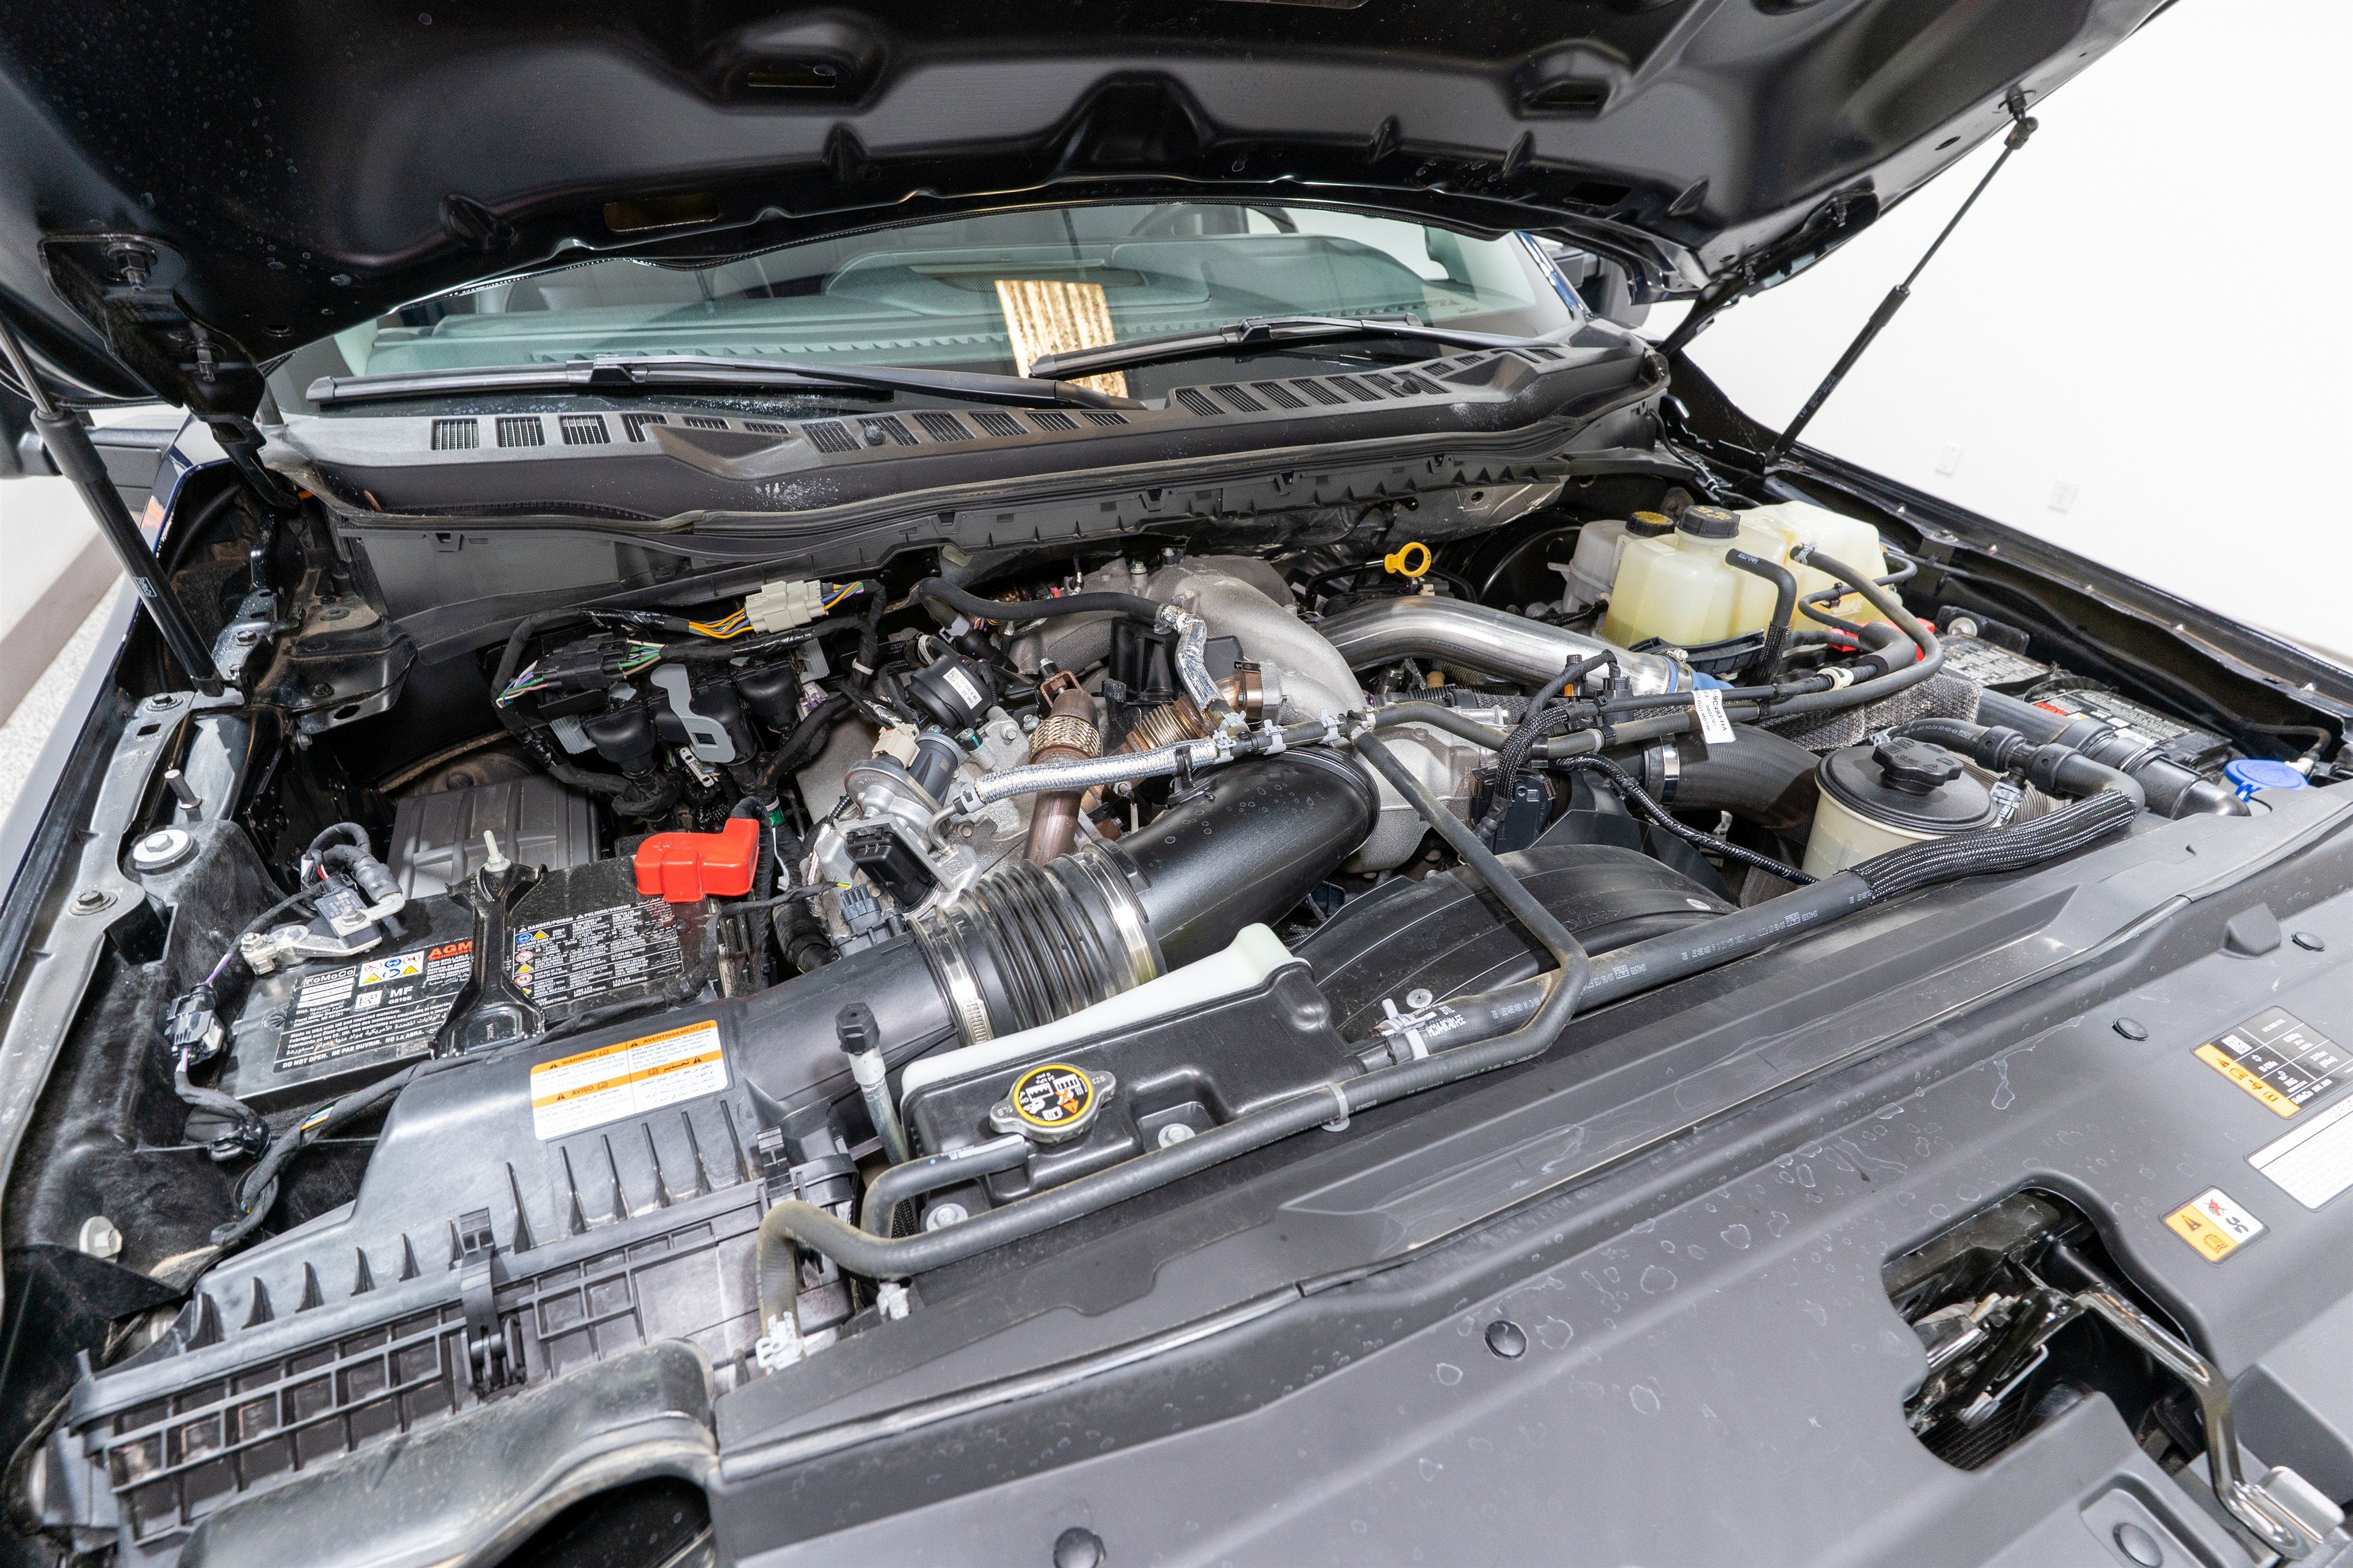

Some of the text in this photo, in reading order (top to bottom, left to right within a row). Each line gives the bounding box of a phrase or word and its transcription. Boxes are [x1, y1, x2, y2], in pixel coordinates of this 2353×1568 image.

[584, 904, 631, 918] PELIGRO/VENENO
[528, 917, 573, 930] DANGER/POISON
[430, 941, 472, 956] AGM
[307, 970, 354, 985] FoMoCo
[390, 986, 413, 998] MF
[538, 996, 568, 1006] STRUCTIONS.
[353, 1014, 375, 1022] imported
[643, 1026, 699, 1043] AVERTISSEMENT
[308, 1053, 327, 1062] OPEN.
[356, 1040, 381, 1050] OUVRIR.
[406, 1030, 424, 1038] ABRA.
[561, 1053, 596, 1065] WARNING
[572, 1086, 593, 1096] AVISO
